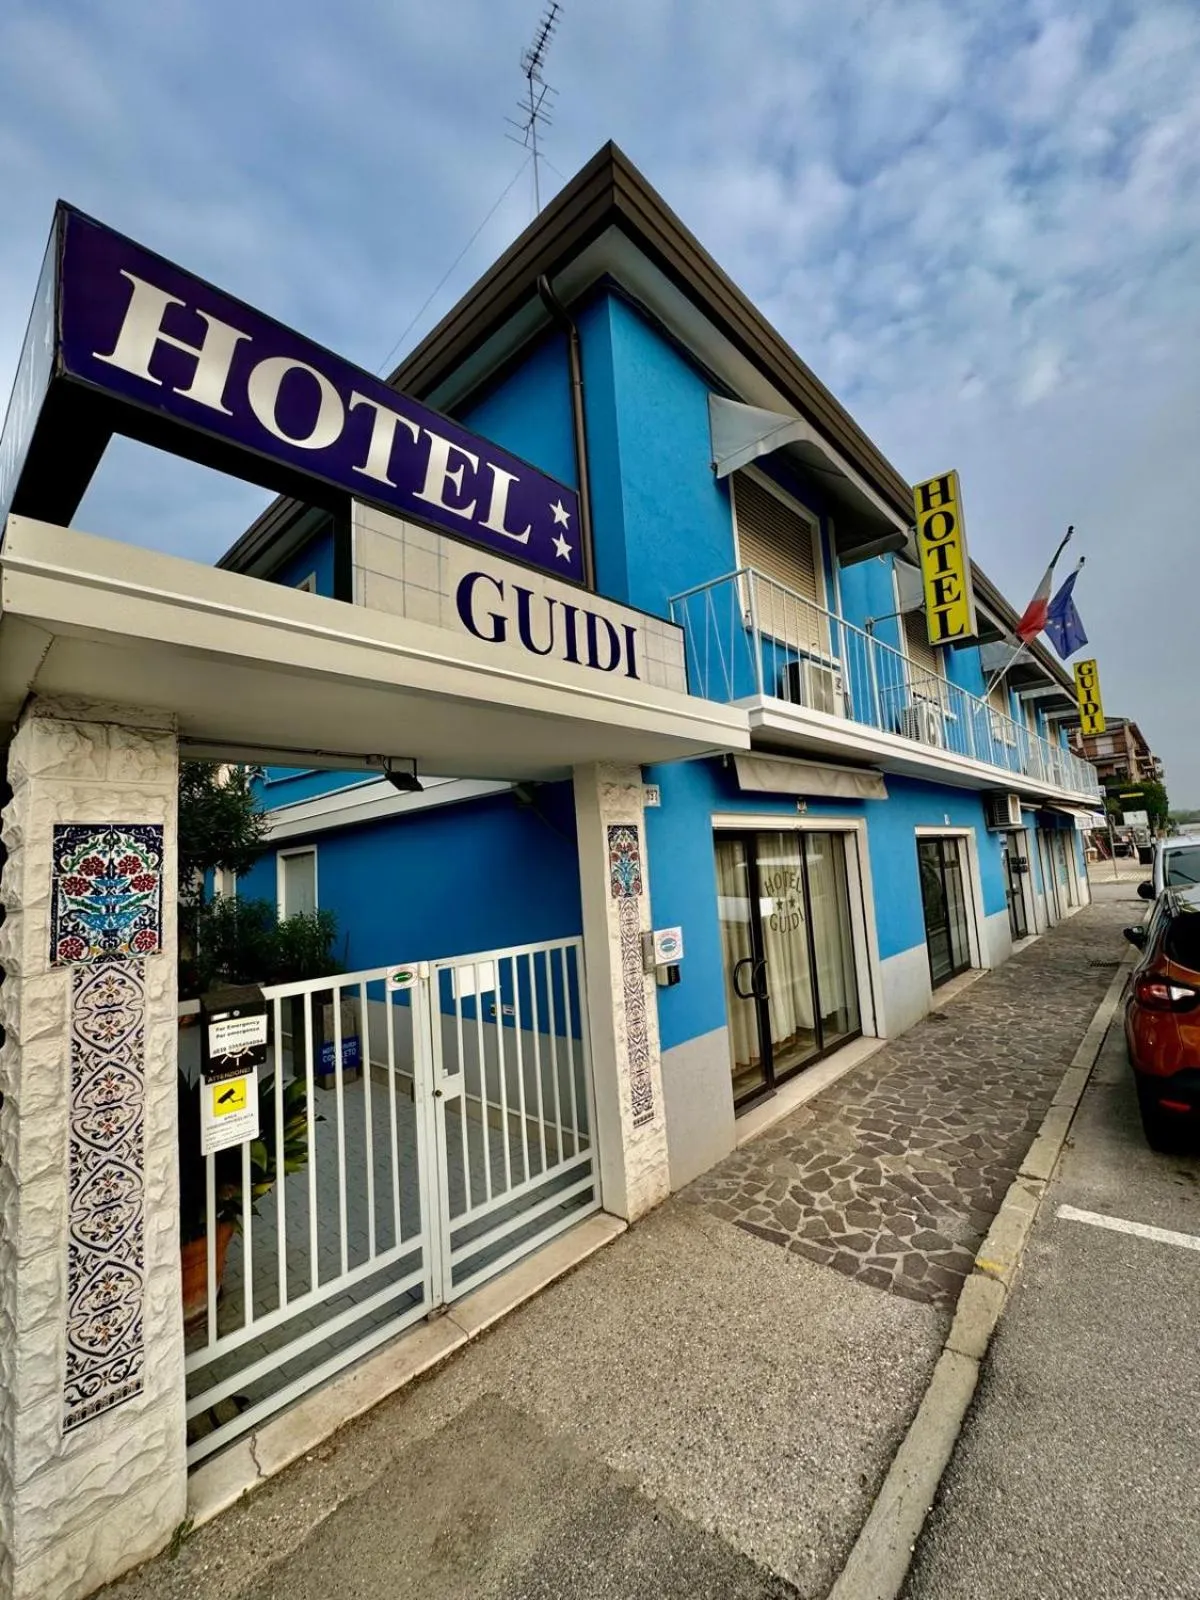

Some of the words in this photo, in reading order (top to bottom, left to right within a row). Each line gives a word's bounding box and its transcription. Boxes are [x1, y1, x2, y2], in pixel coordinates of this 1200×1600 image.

[92, 268, 532, 545] HOTEL
[917, 473, 965, 641] HOTEL
[455, 570, 641, 680] GUIDI
[1077, 659, 1099, 730] GUIDI
[764, 870, 803, 895] HOTEL
[769, 907, 805, 934] GUIDI
